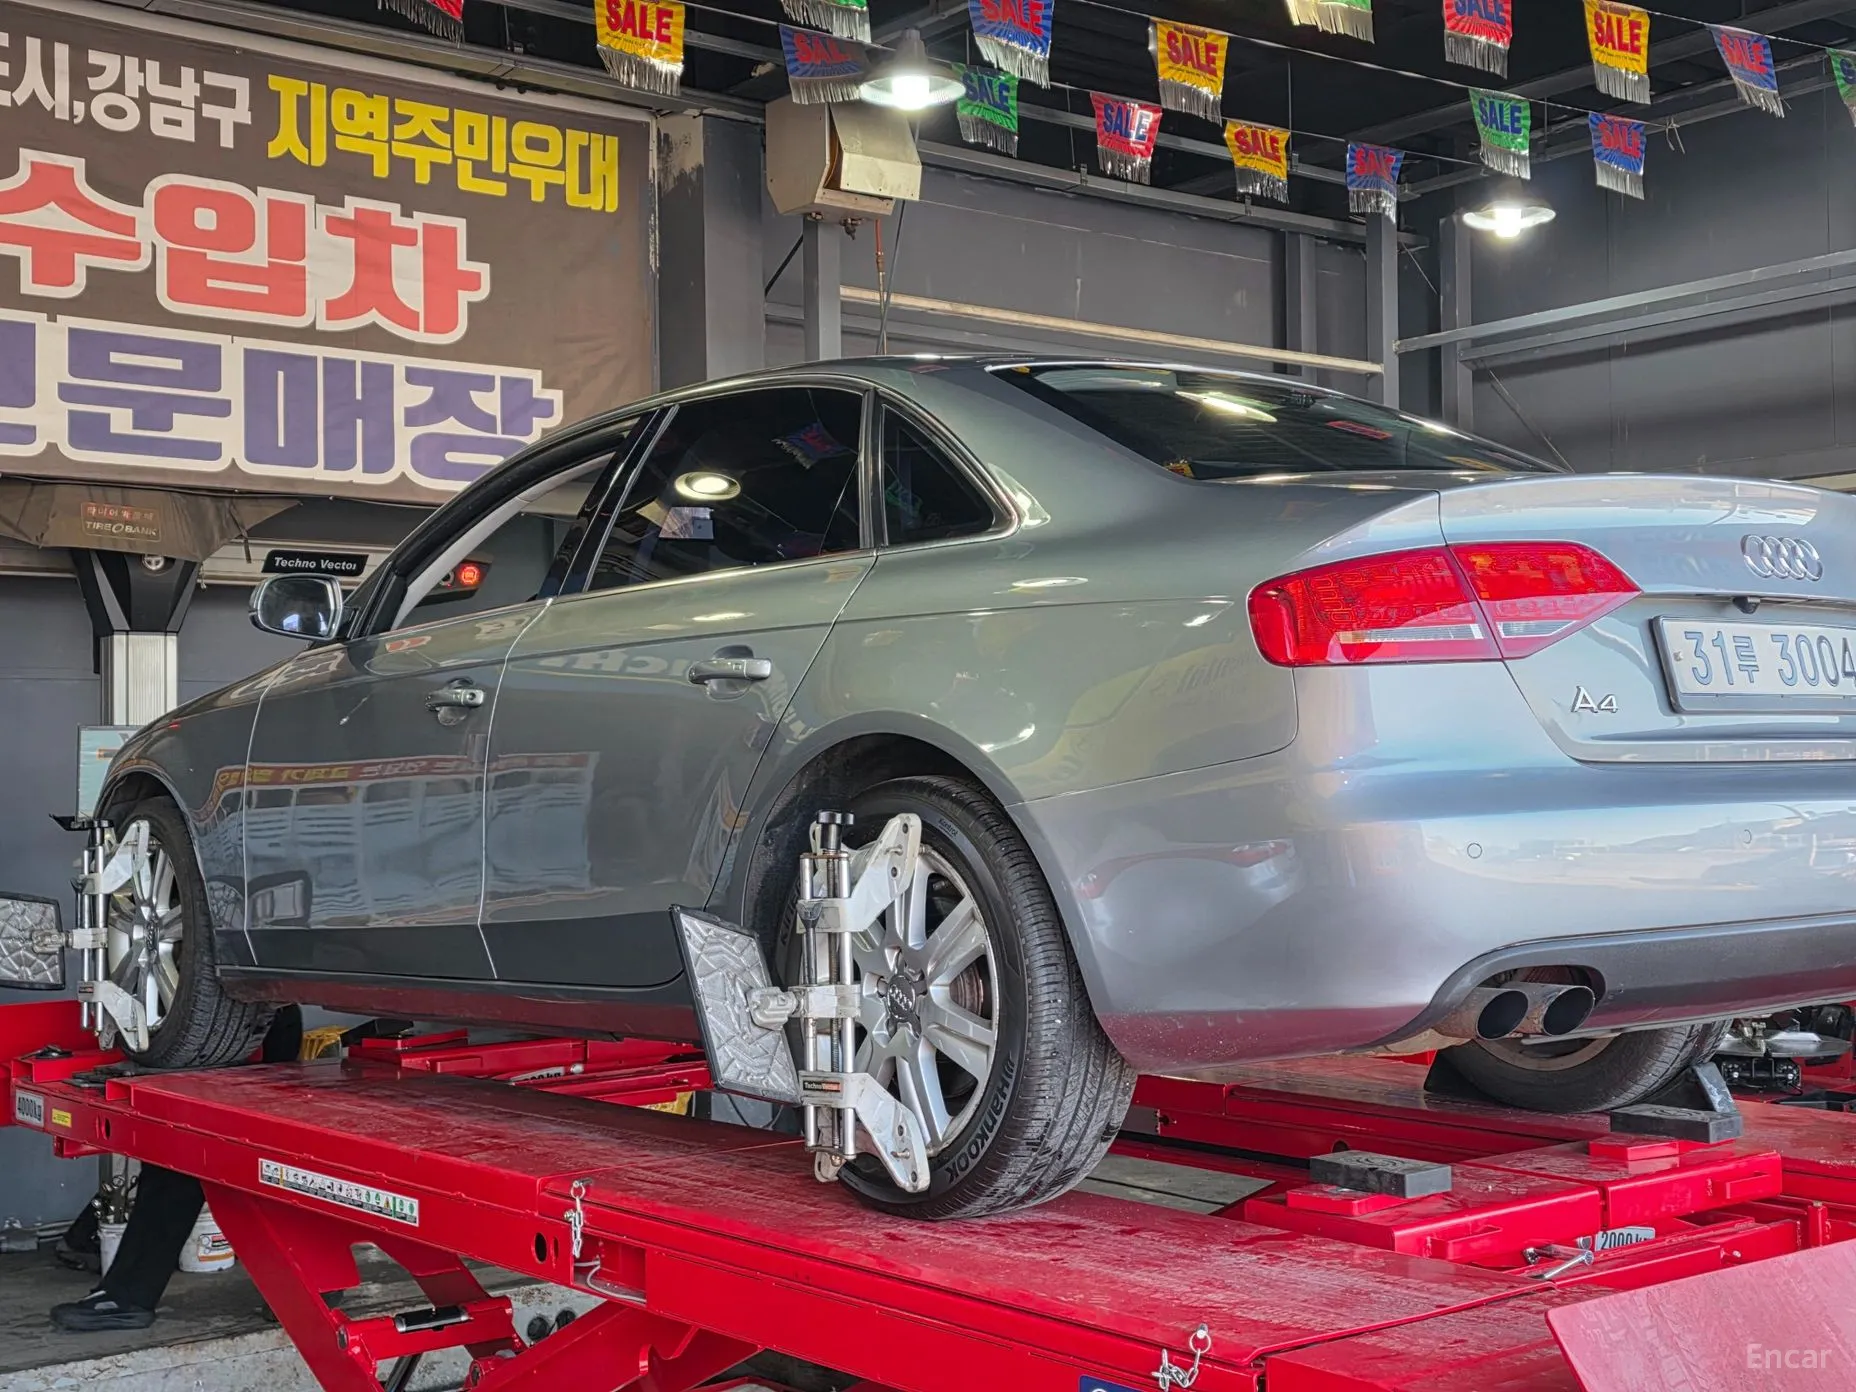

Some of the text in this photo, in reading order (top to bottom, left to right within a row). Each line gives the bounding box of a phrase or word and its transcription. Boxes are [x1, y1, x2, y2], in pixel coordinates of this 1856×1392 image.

[604, 0, 674, 44] SALE
[980, 0, 1044, 37] SALE
[1593, 12, 1642, 55] SALE
[793, 32, 855, 66] SAL
[1166, 31, 1218, 77] SALE
[1721, 34, 1768, 74] SALE
[962, 71, 1011, 113] SALE
[1103, 103, 1153, 143] SALE
[1478, 99, 1523, 134] SALE
[267, 74, 619, 213] 지역주민우대
[1234, 129, 1282, 164] SALE
[1598, 122, 1642, 158] SALE
[0, 150, 490, 342] 수입차
[274, 557, 316, 568] Techno
[1684, 630, 1856, 687] 31루 3004
[1570, 685, 1619, 714] A4
